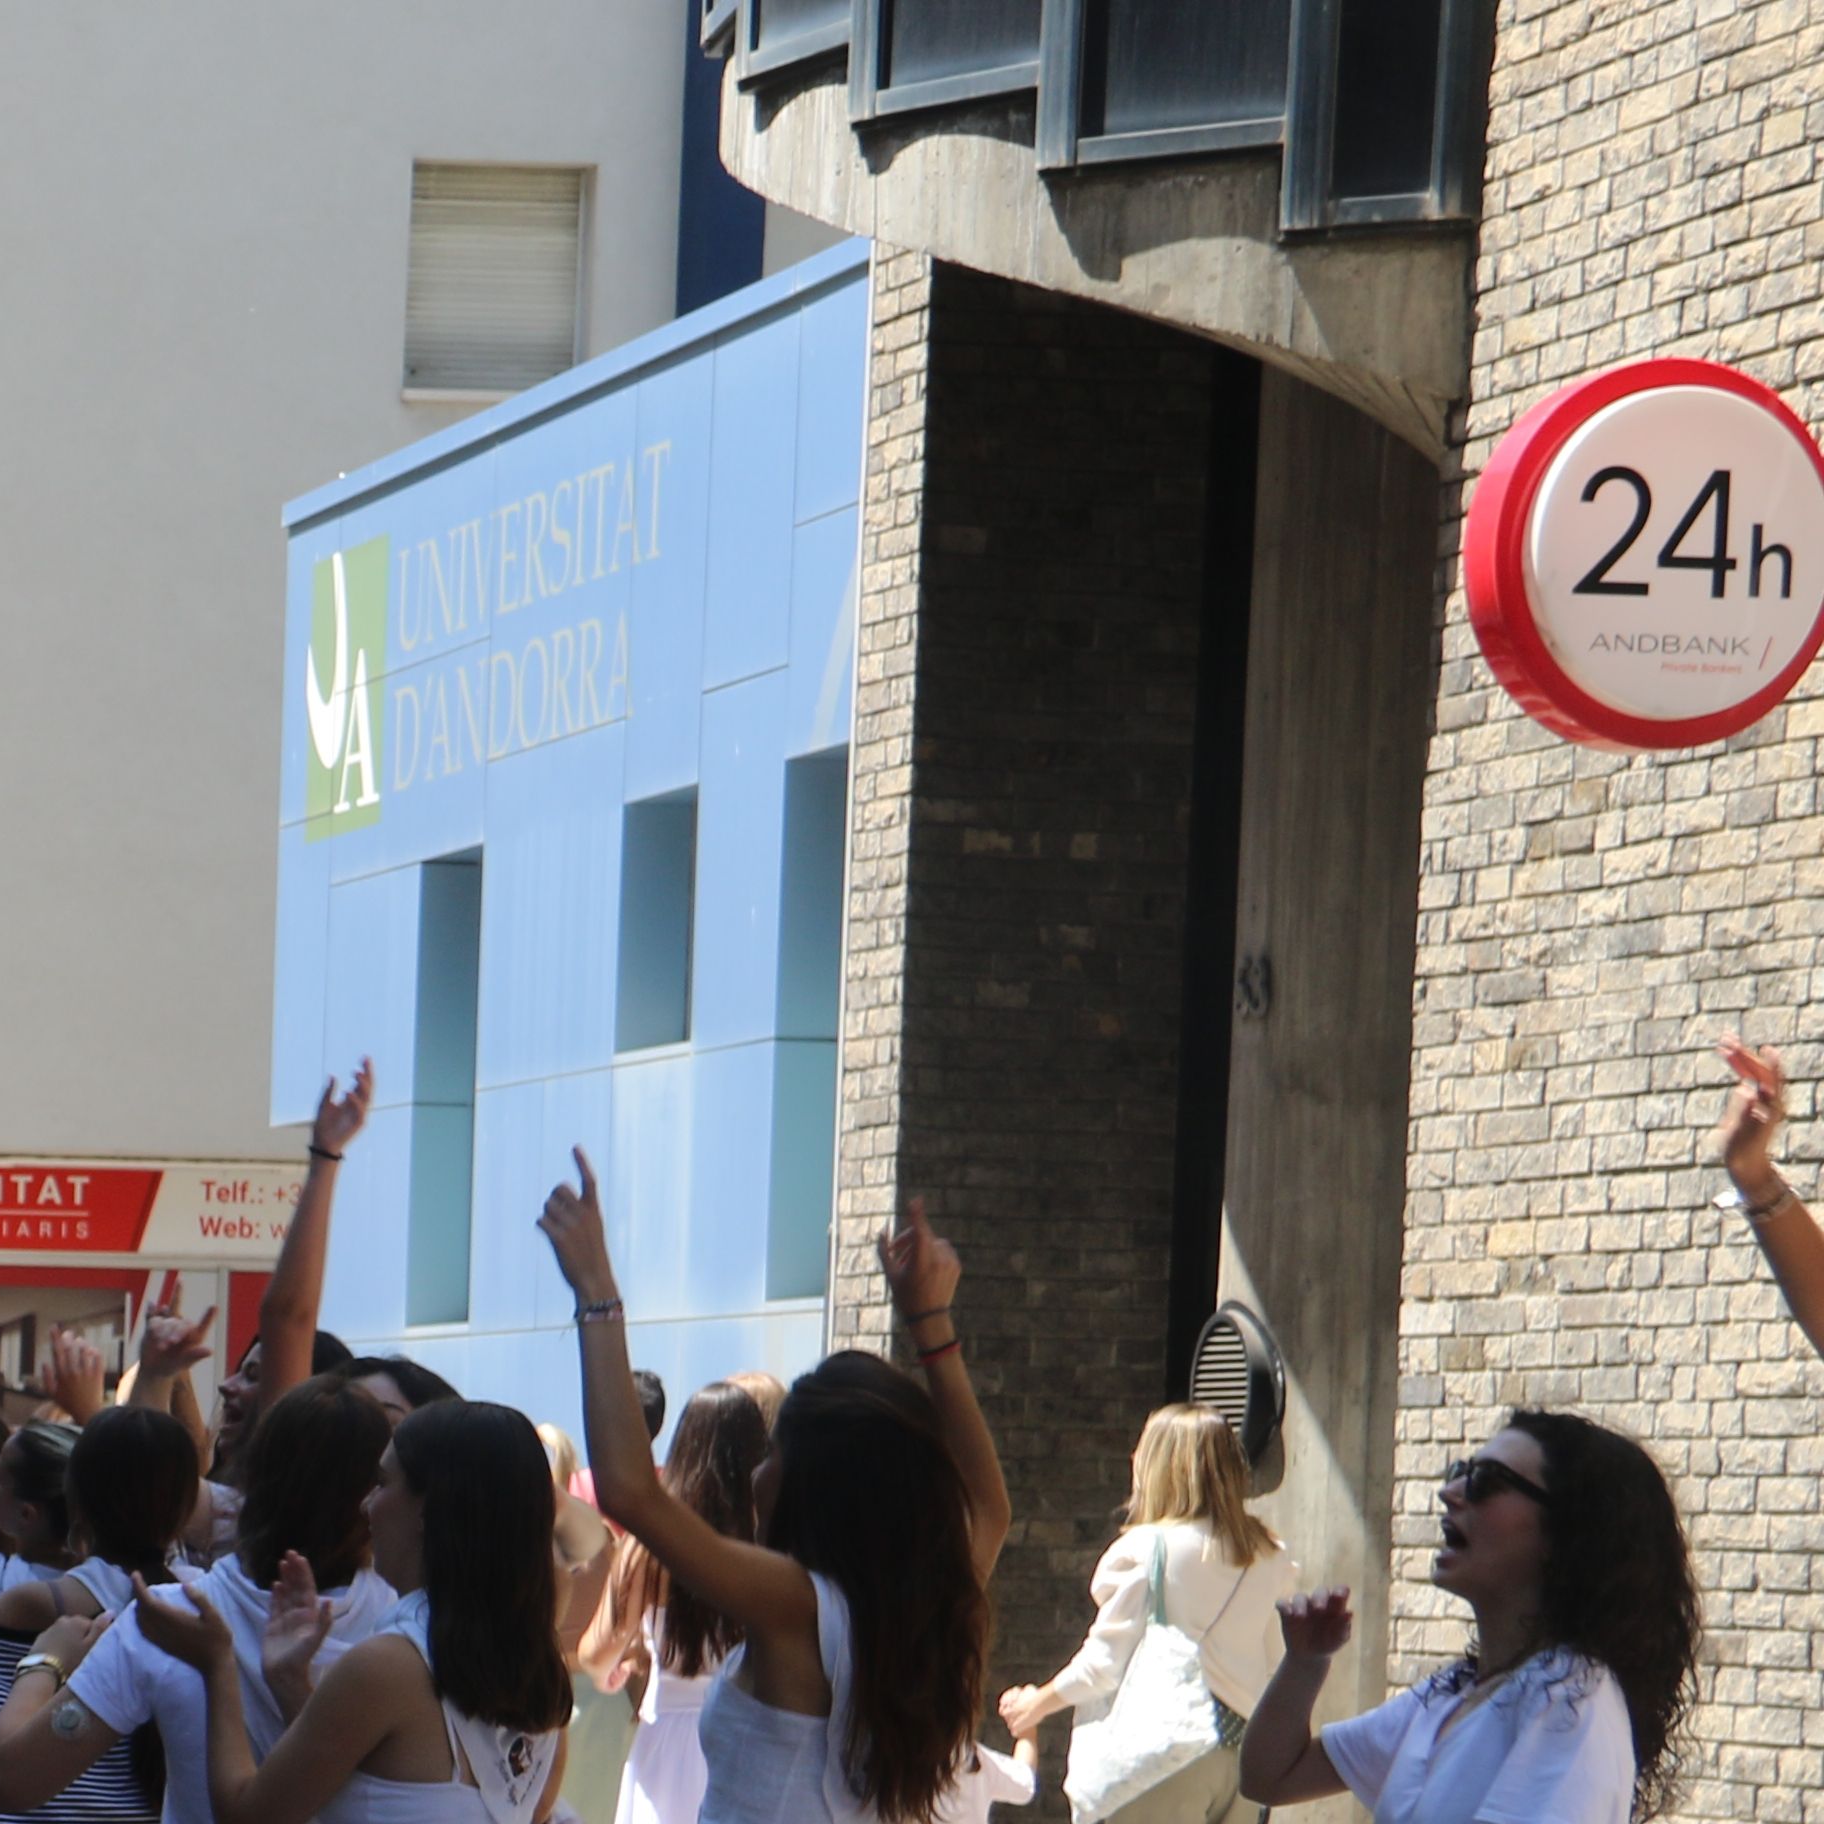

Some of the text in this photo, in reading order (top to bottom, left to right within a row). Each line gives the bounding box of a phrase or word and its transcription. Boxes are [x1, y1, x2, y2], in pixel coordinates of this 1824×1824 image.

[397, 439, 672, 652] UNIVERSITAT
[1571, 464, 1793, 599] 24h
[1588, 632, 1750, 656] ANDBANK
[393, 608, 634, 792] D'ANDORRA
[199, 1216, 261, 1239] Web:
[200, 1179, 263, 1203] Telf.:
